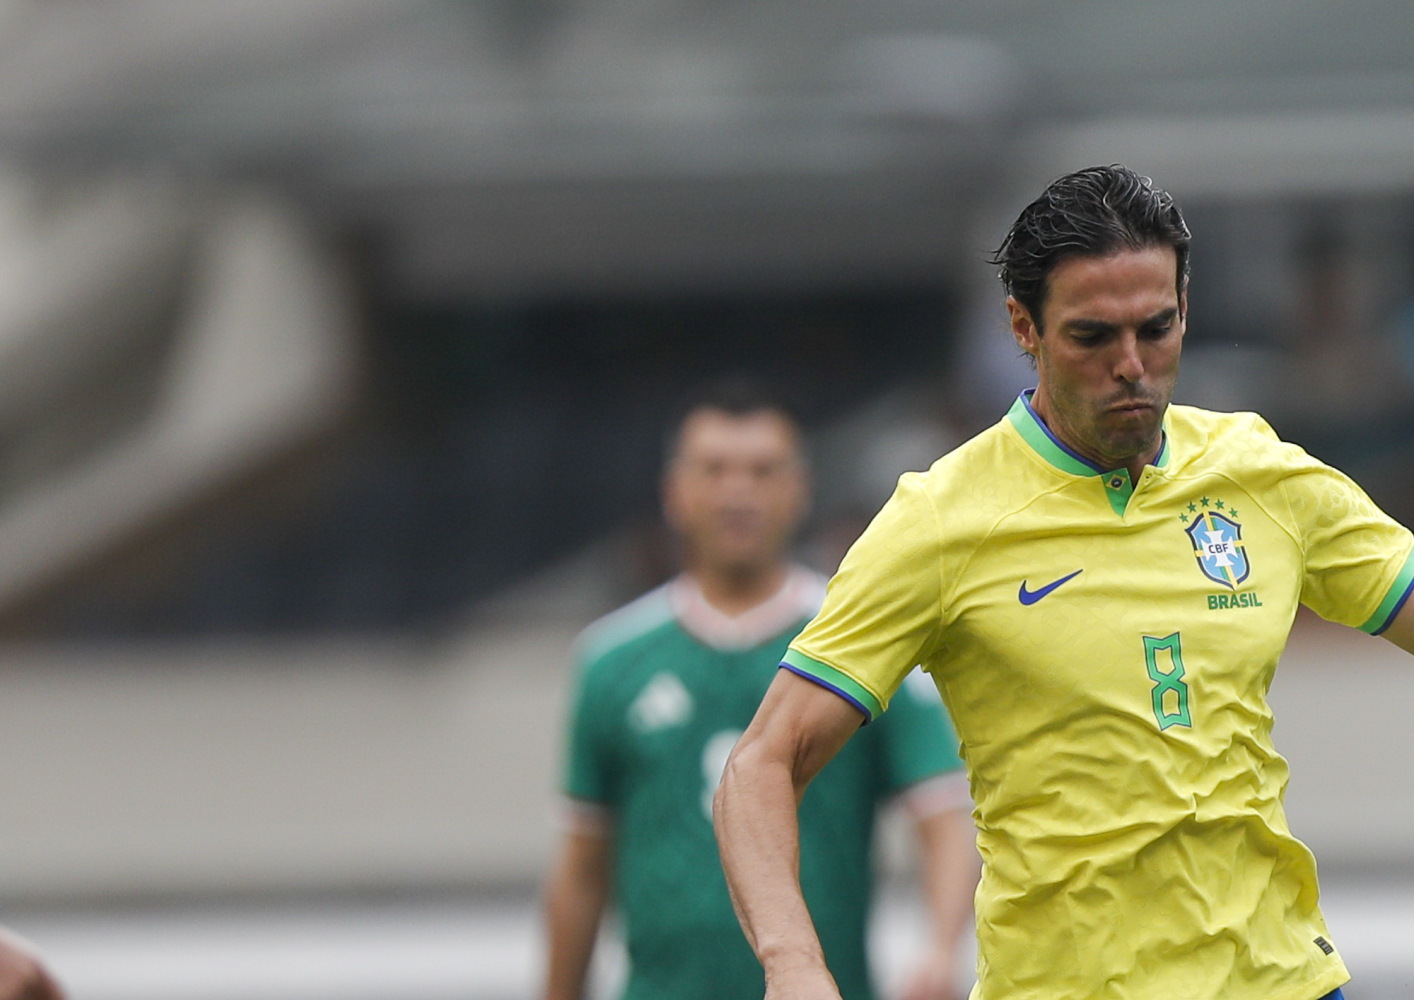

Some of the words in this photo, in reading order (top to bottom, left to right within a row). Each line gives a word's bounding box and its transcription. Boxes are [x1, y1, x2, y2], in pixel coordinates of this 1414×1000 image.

[1208, 543, 1230, 554] CBF
[1207, 592, 1263, 610] BRASIL
[1141, 630, 1192, 731] 8
